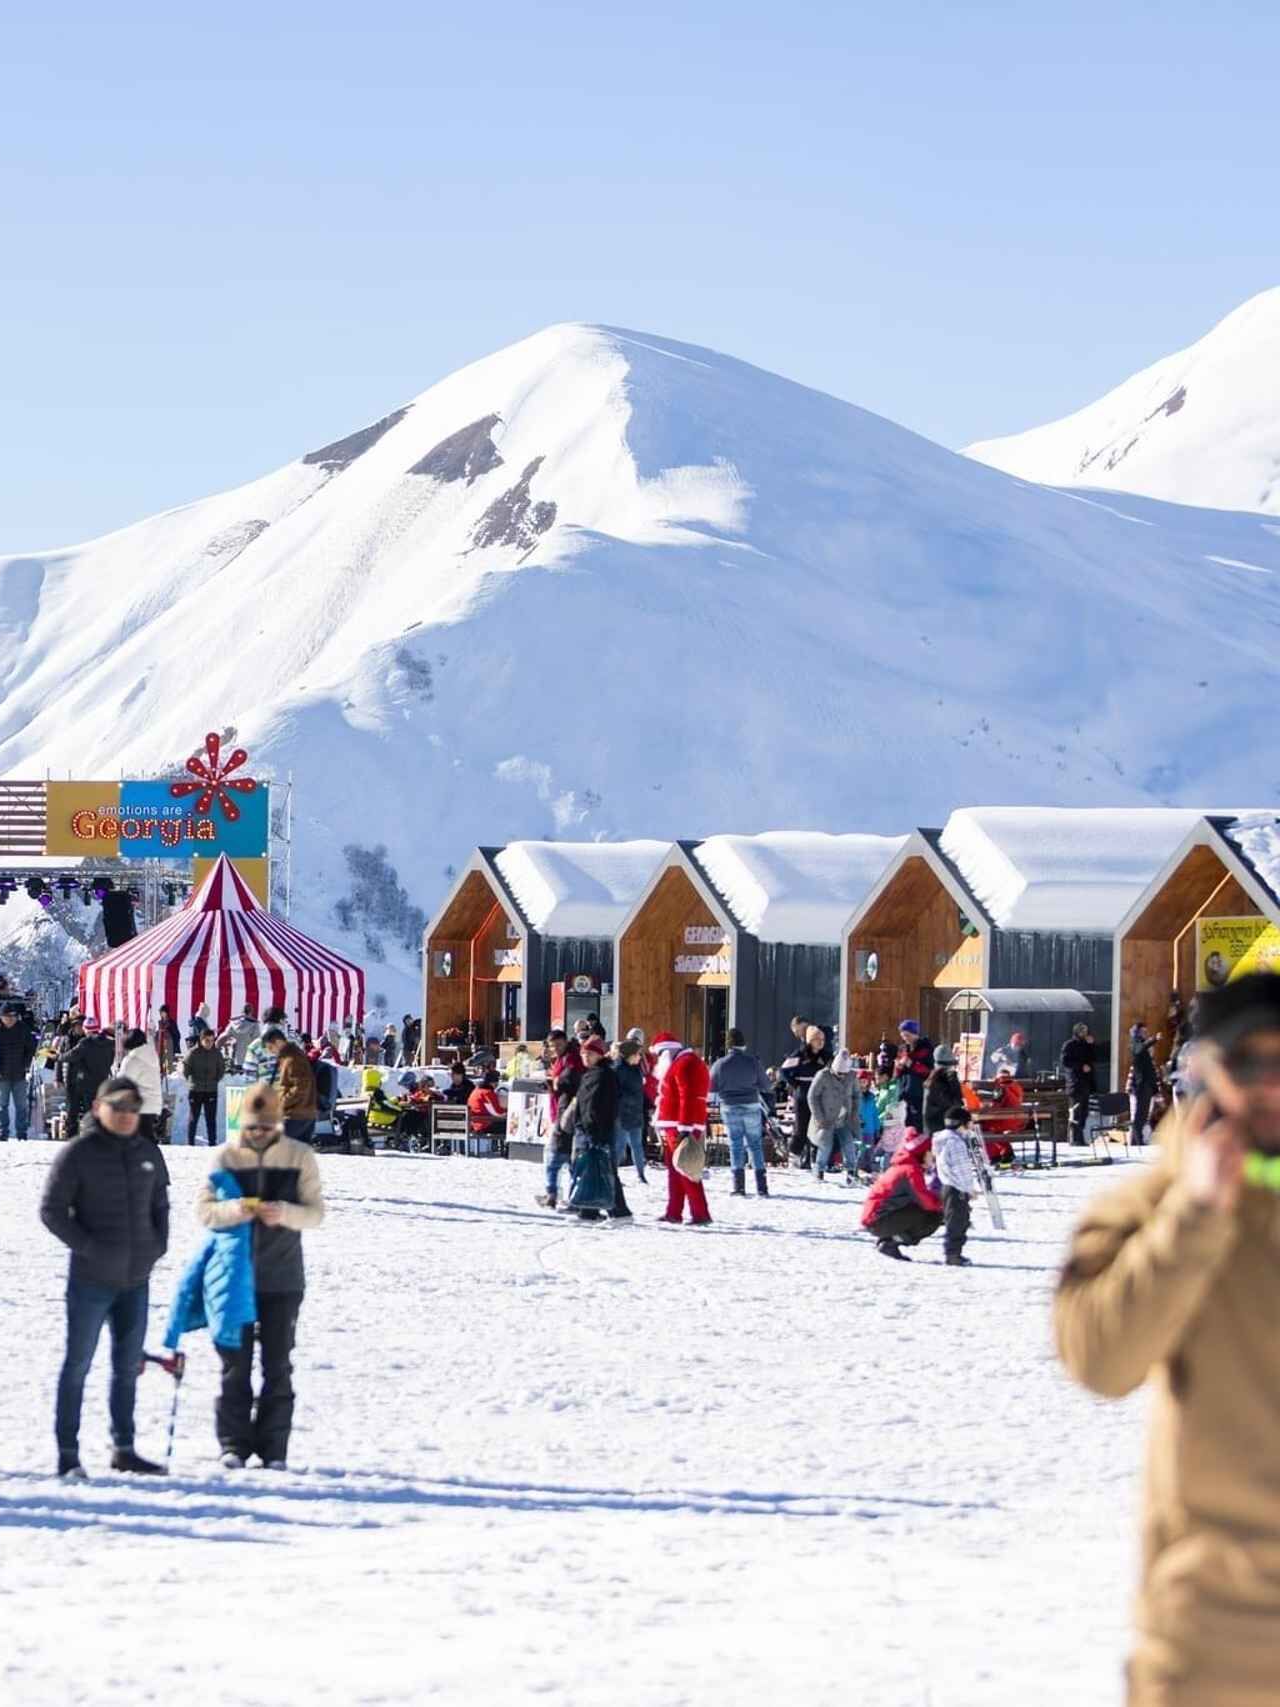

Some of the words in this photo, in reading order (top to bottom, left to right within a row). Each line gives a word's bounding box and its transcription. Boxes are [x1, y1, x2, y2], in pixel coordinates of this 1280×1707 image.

[98, 805, 158, 816] emotions
[161, 805, 182, 816] are
[72, 810, 216, 847] Georgia
